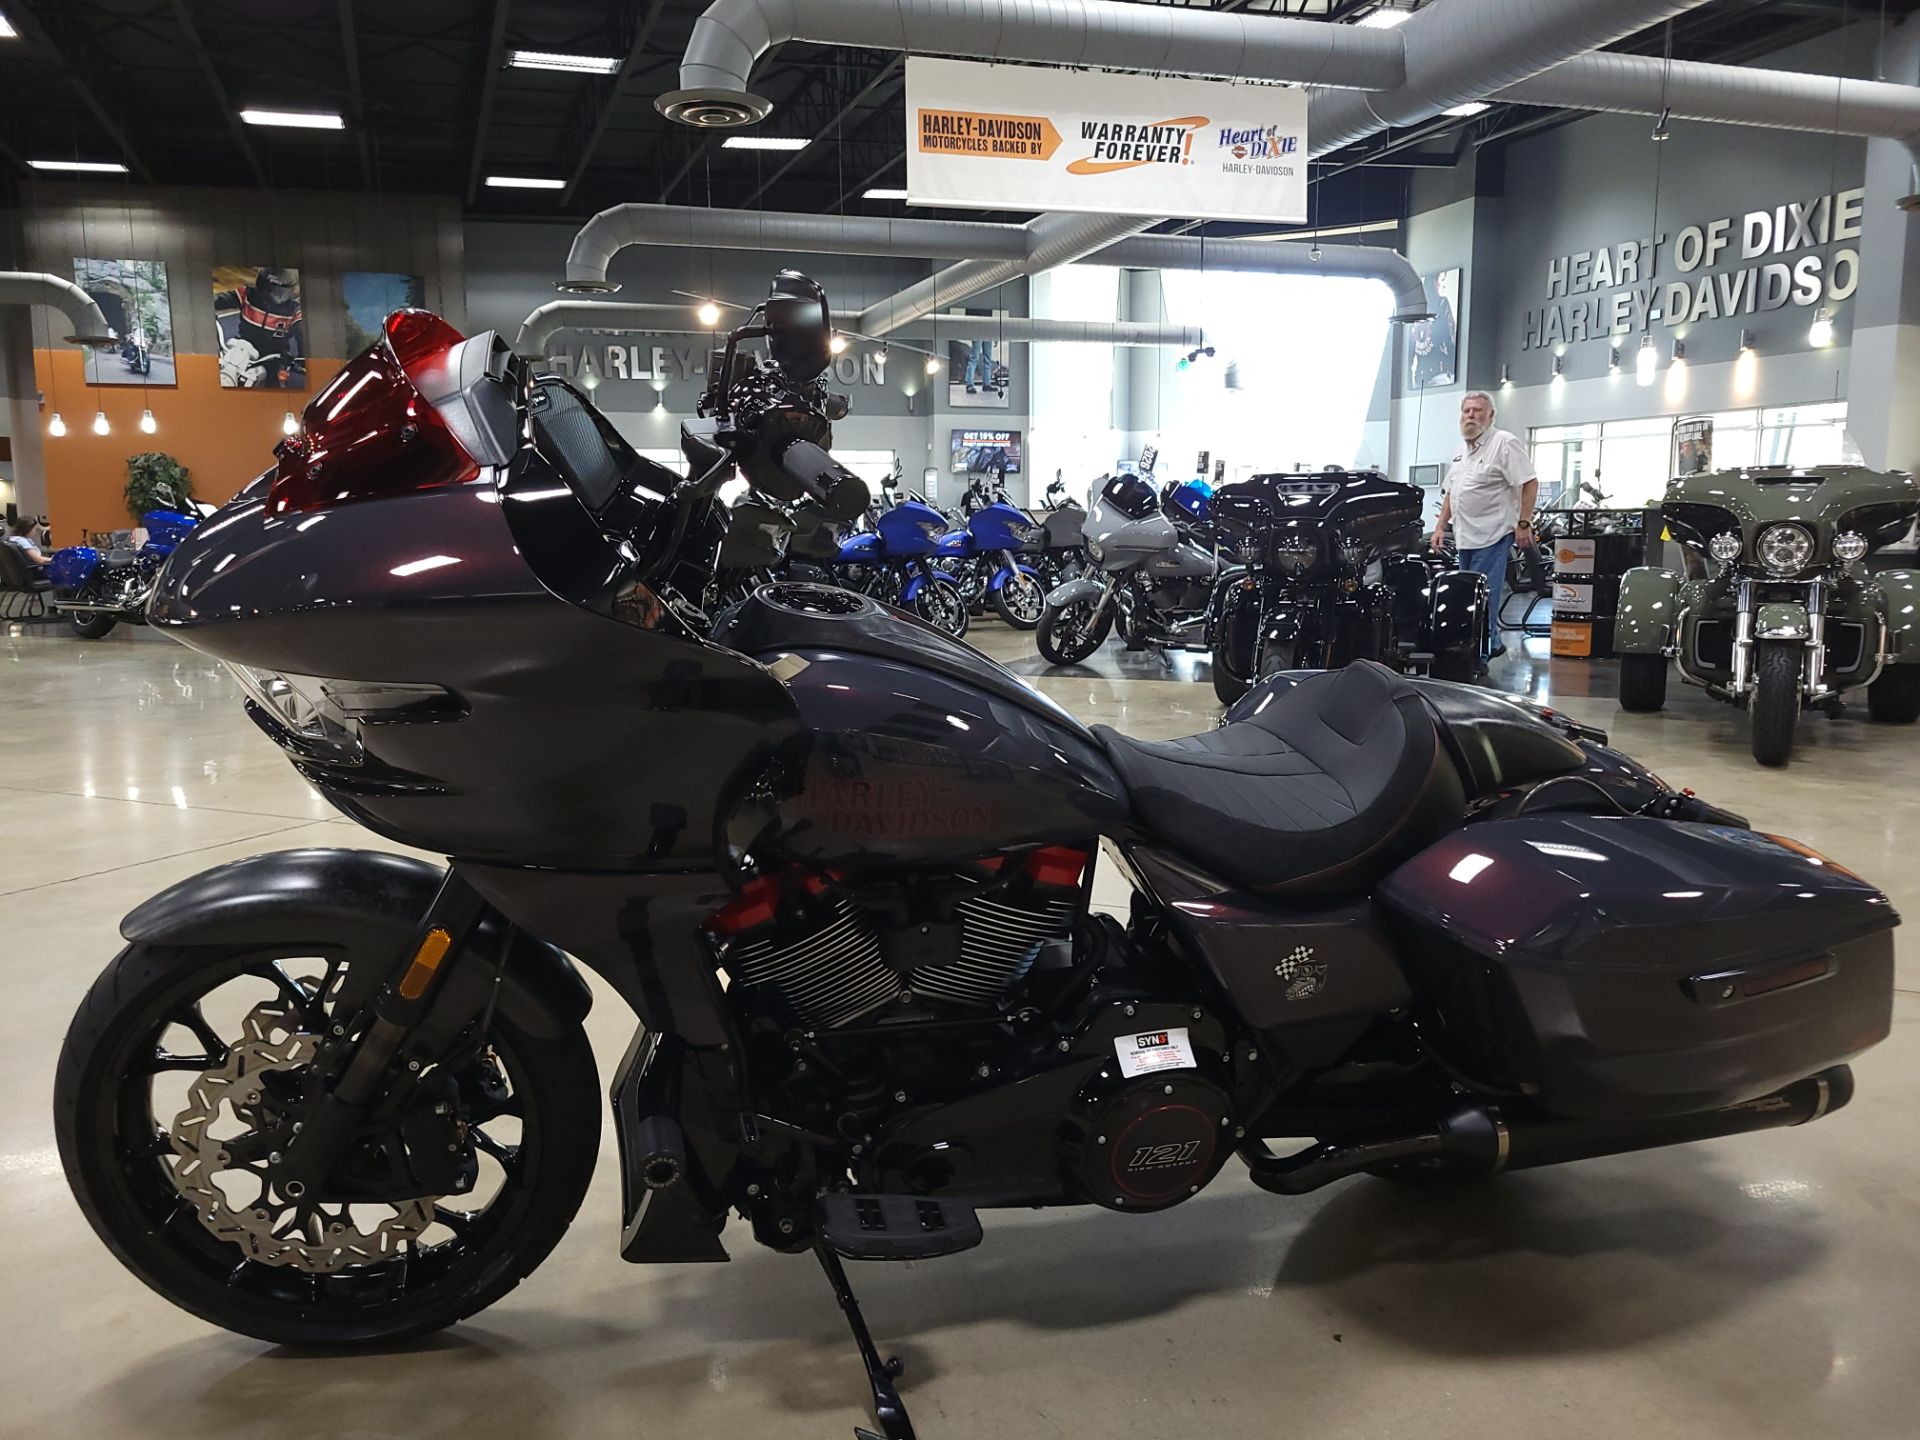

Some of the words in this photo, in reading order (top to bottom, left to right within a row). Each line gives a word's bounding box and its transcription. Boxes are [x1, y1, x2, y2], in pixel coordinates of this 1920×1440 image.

[923, 114, 1041, 140] HARLEY-DAVIDSON
[1081, 121, 1187, 145] WARRANTY
[1219, 126, 1265, 148] Heart
[1266, 124, 1278, 137] of
[923, 134, 988, 152] MOTORCYCLES
[992, 139, 1027, 154] BACKED
[1031, 142, 1042, 155] BY
[1250, 136, 1298, 159] DIXIE
[1222, 162, 1294, 176] HARLEY-DAVIDSON
[1546, 233, 1665, 300] HEART
[1674, 217, 1731, 273] OF
[1741, 187, 1865, 260] DIXIE
[552, 344, 885, 386] HARLEY-ON
[963, 431, 979, 440] GET
[995, 432, 1010, 441] OFF
[831, 803, 992, 836] DAVIDSON
[1137, 1033, 1167, 1047] SYN3
[1129, 1140, 1200, 1167] 121
